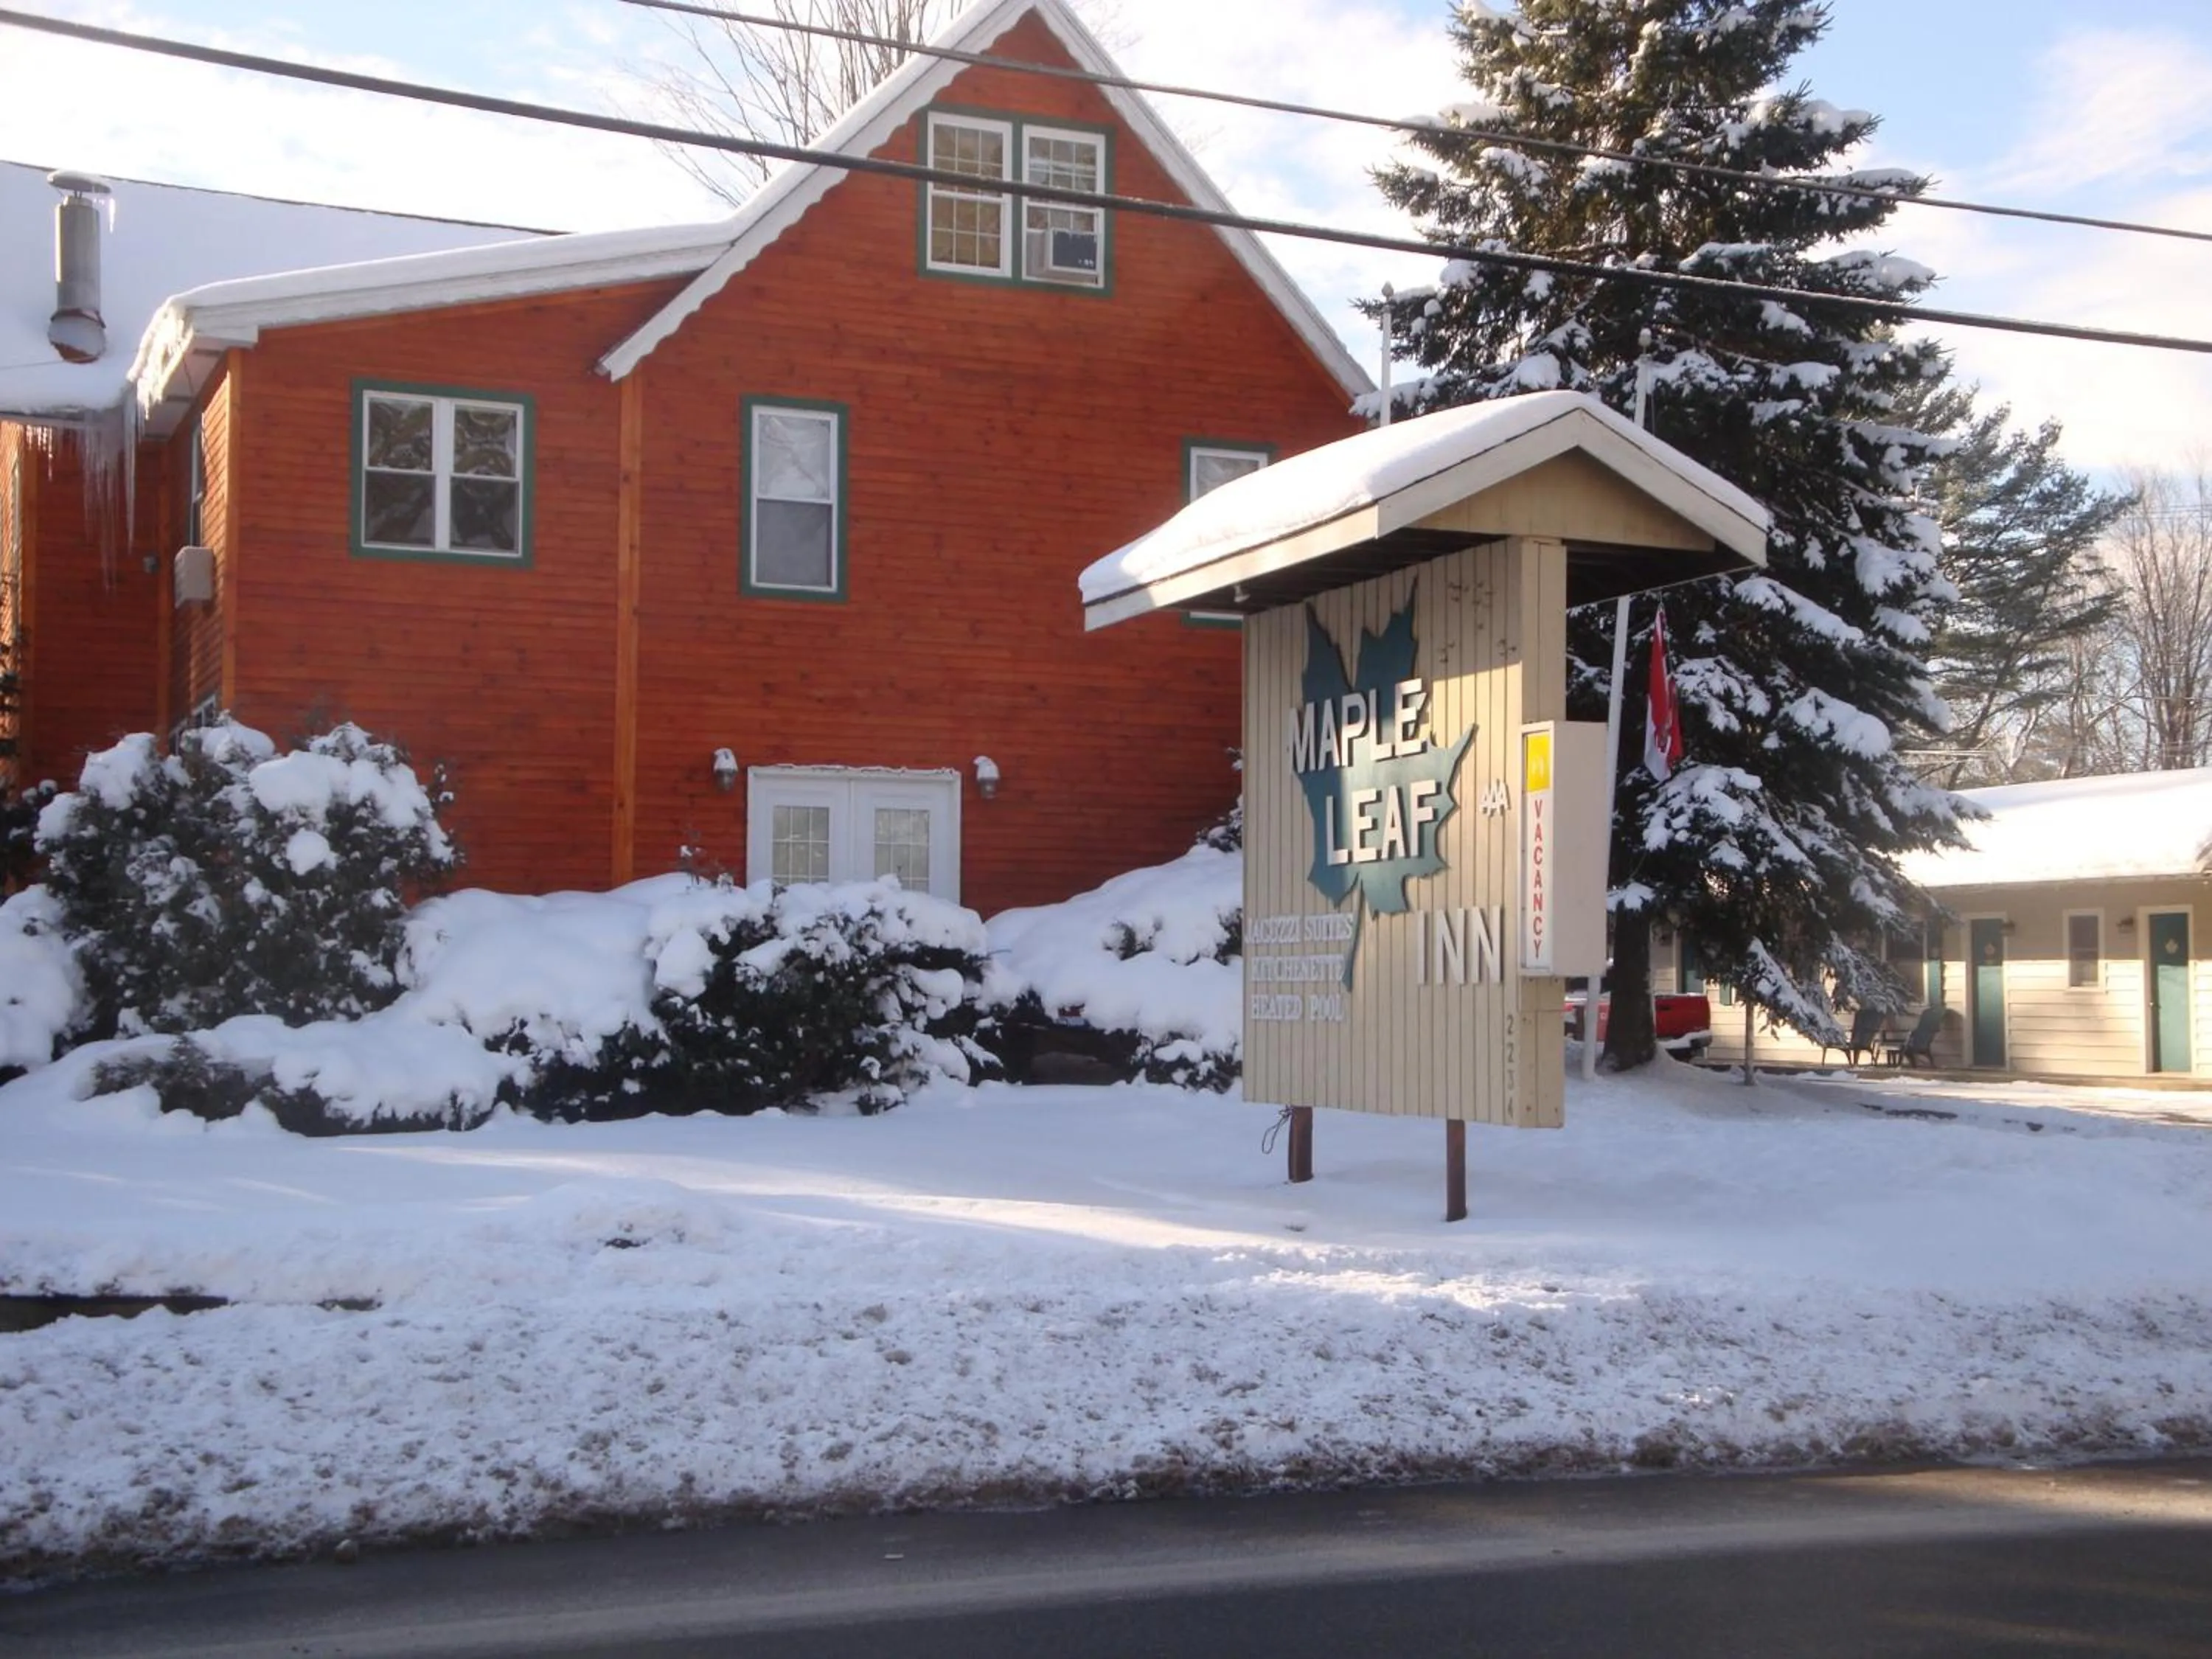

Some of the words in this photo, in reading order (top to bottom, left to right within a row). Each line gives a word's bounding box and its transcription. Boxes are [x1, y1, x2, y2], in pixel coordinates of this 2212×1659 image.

[1290, 678, 1422, 773] MAPLE
[1326, 779, 1436, 866] LEAF
[1533, 799, 1543, 959] VACANCY
[1304, 912, 1353, 941] SUITES
[1417, 905, 1502, 985] INN
[1251, 995, 1302, 1020] HEATED
[1310, 994, 1344, 1021] POOL
